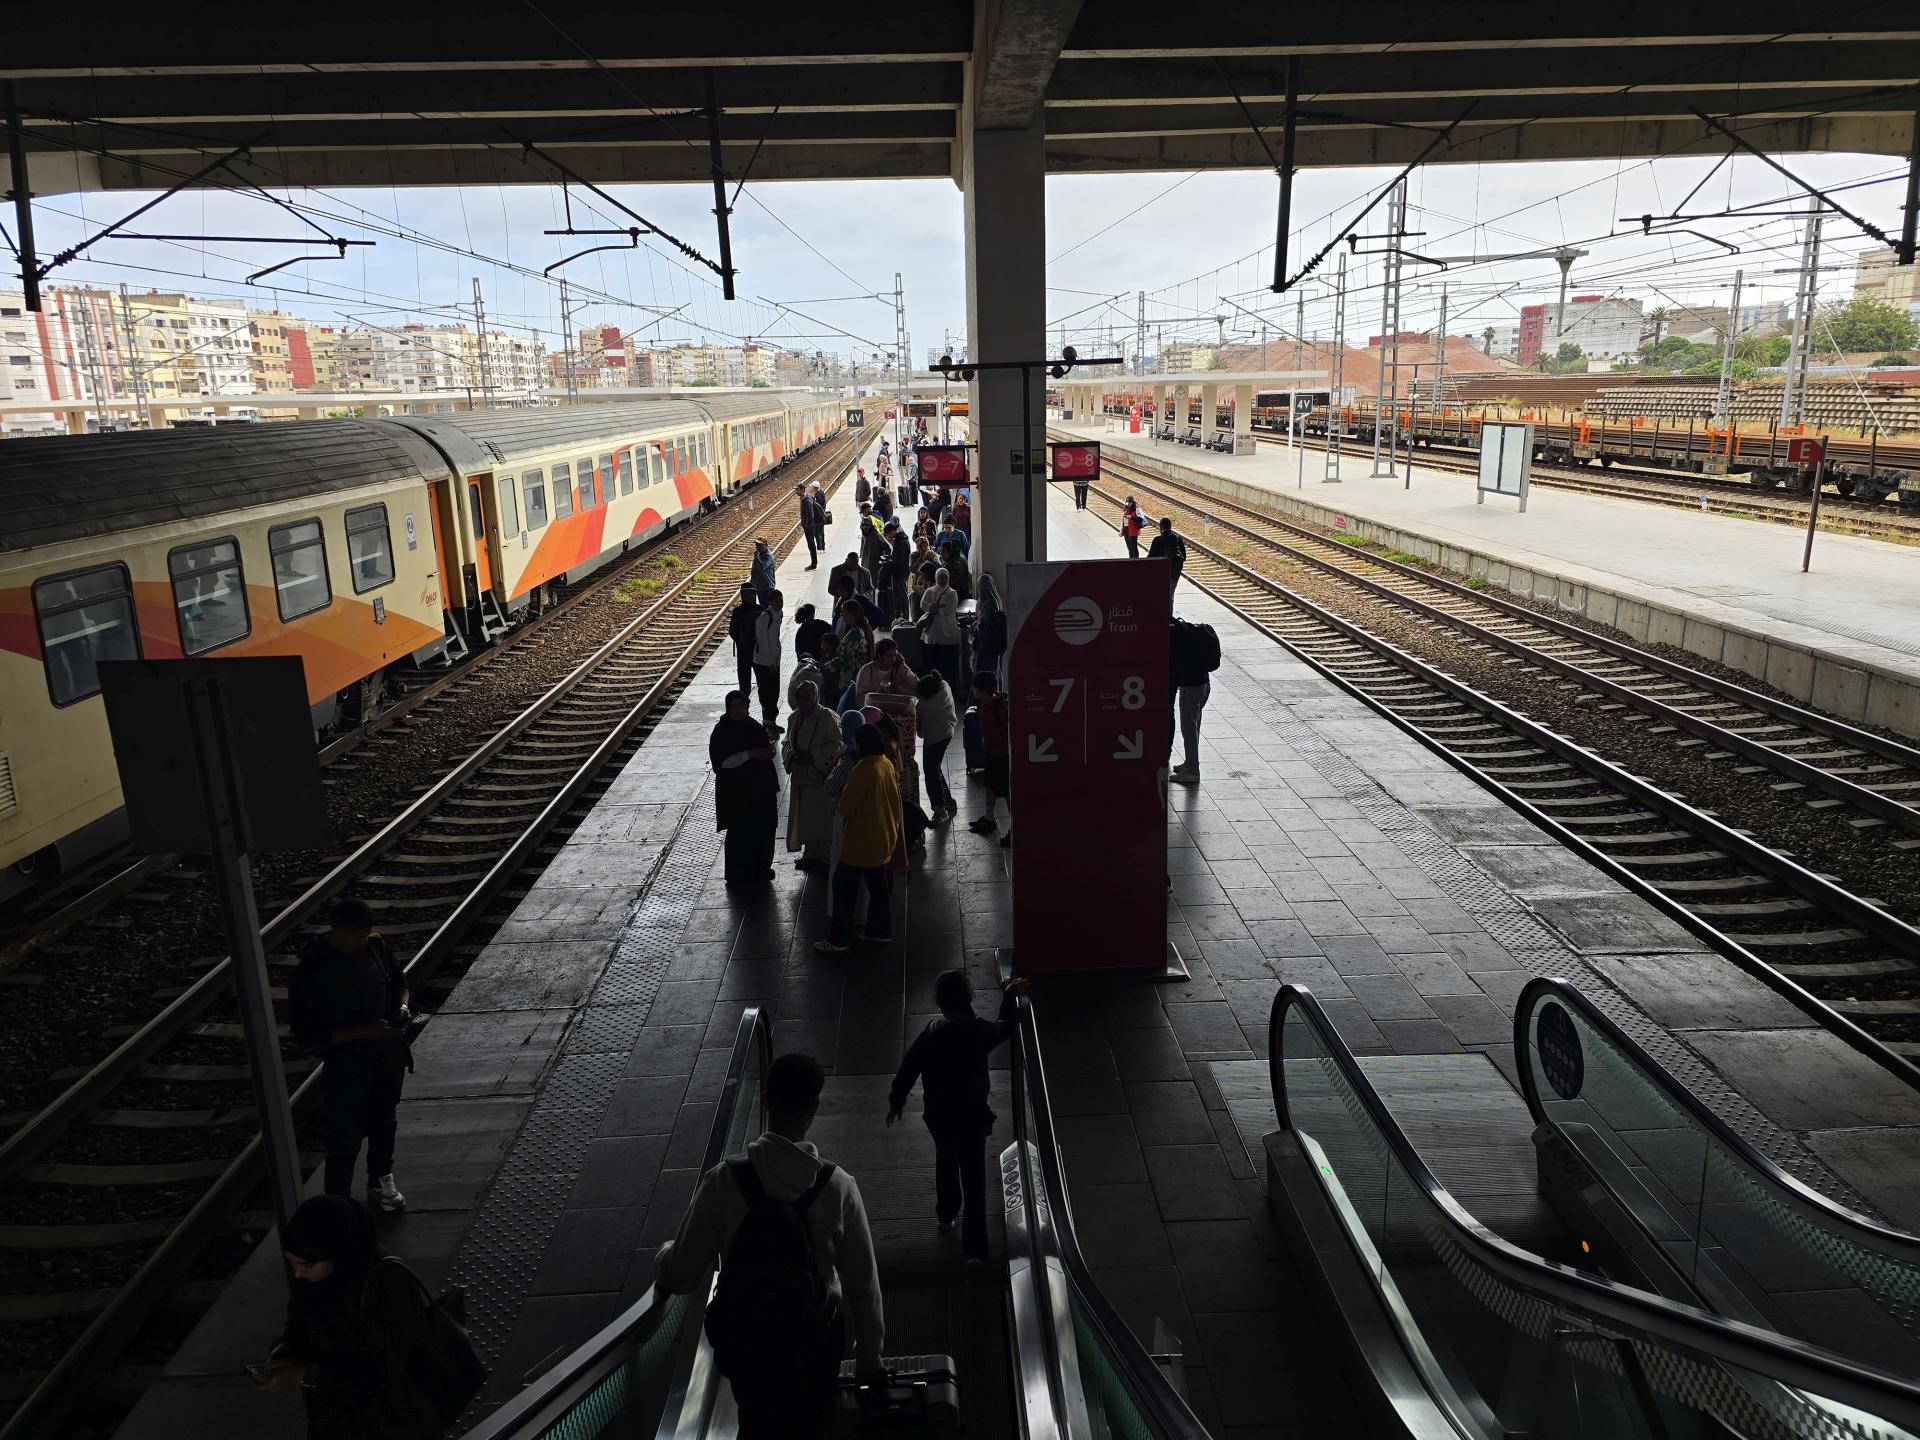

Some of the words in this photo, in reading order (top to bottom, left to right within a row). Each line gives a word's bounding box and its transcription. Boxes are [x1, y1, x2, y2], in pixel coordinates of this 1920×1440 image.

[1297, 400, 1310, 409] 4V
[849, 413, 861, 423] 4V
[1800, 441, 1811, 459] E
[950, 460, 959, 473] 7
[1085, 454, 1094, 467] 8
[1108, 605, 1133, 620] قطار
[1108, 621, 1138, 632] Train
[1048, 677, 1075, 713] 7
[1121, 675, 1146, 711] 8
